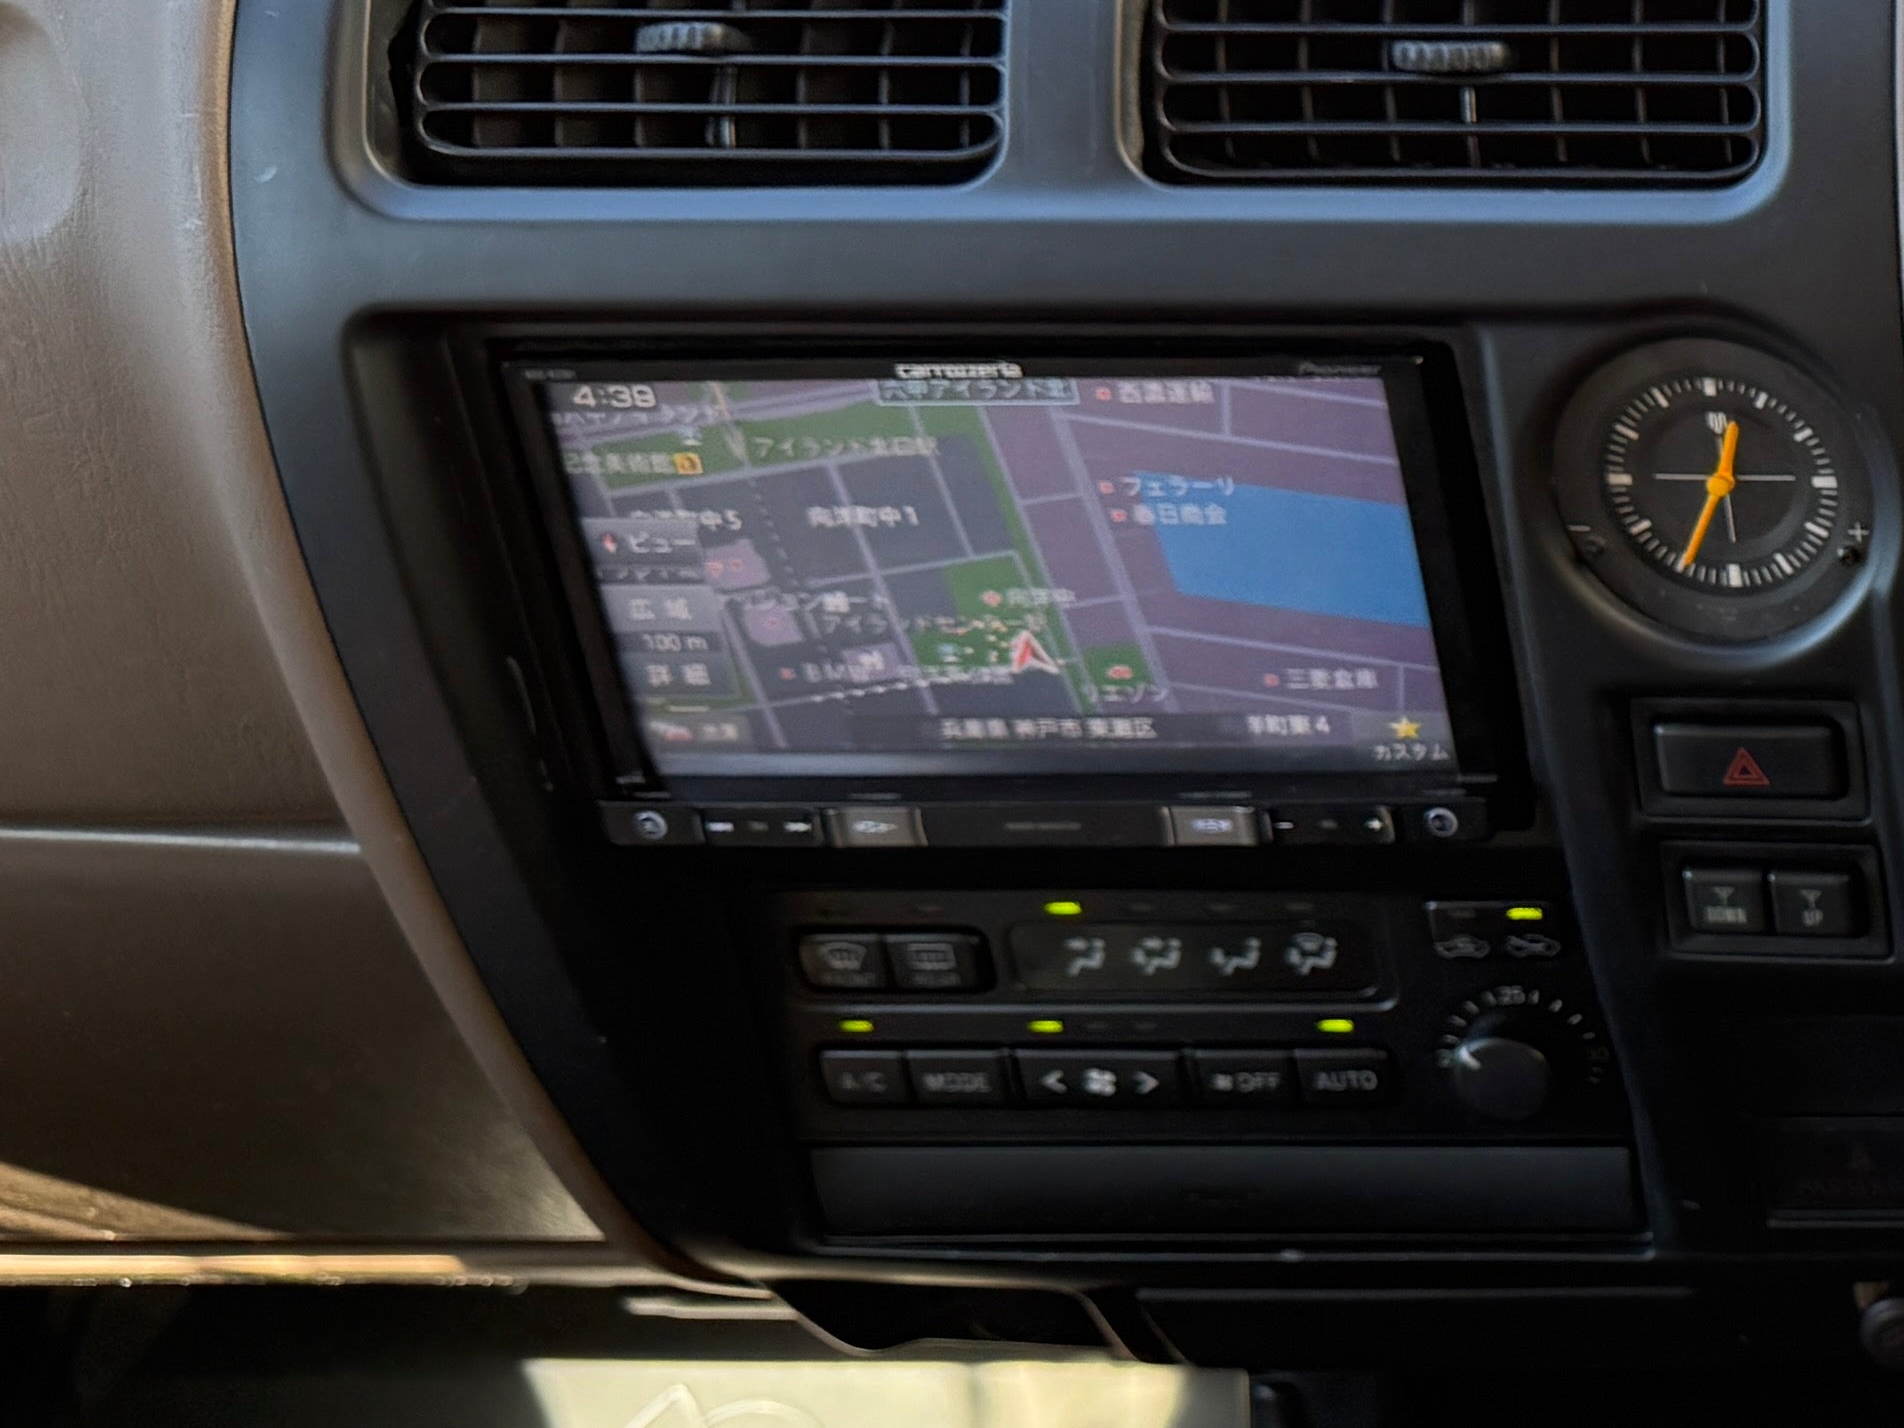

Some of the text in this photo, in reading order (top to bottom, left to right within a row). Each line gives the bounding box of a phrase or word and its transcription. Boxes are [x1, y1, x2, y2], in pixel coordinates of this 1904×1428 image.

[1120, 475, 1235, 497] フェラーリ
[1313, 1069, 1379, 1092] AUTO
